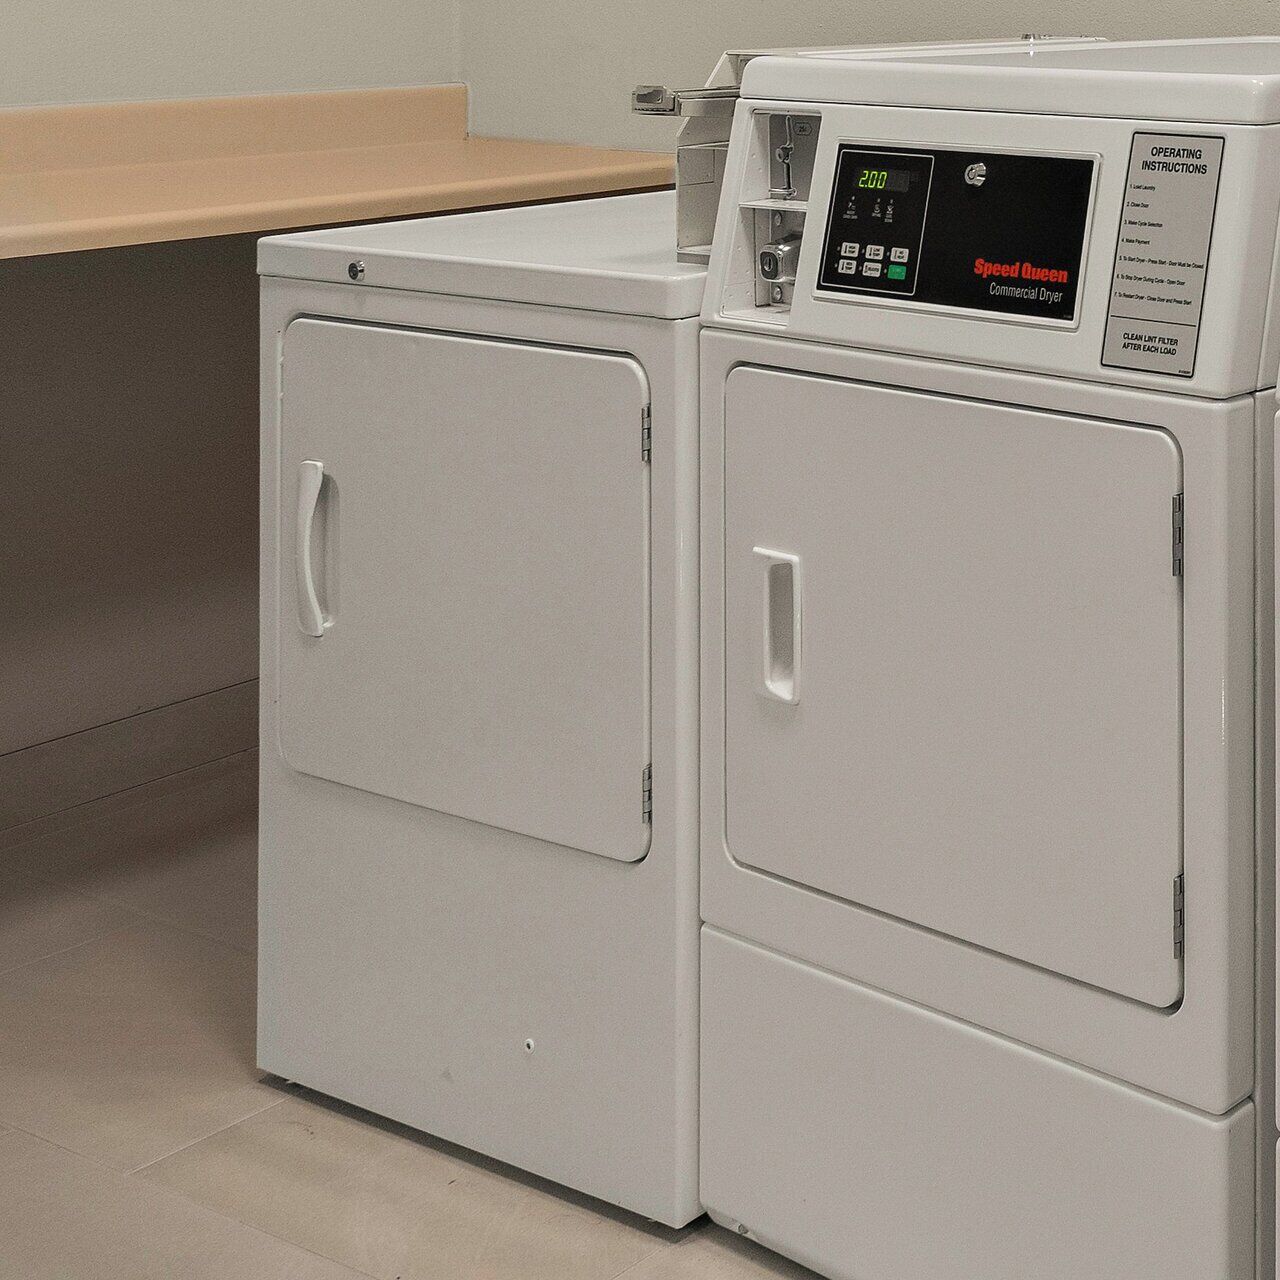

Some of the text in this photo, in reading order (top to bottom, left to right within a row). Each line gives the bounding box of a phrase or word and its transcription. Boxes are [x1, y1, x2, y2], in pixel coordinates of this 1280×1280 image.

[1151, 147, 1202, 159] OPERATING
[1142, 161, 1207, 174] INSTRUCTIONS
[974, 258, 1068, 282] Speed Queen
[990, 282, 1063, 304] Commercial Dryer
[1123, 332, 1178, 346] CLEAN LINT FILTER
[1122, 342, 1141, 350] AFTER
[1143, 345, 1158, 353] EACH
